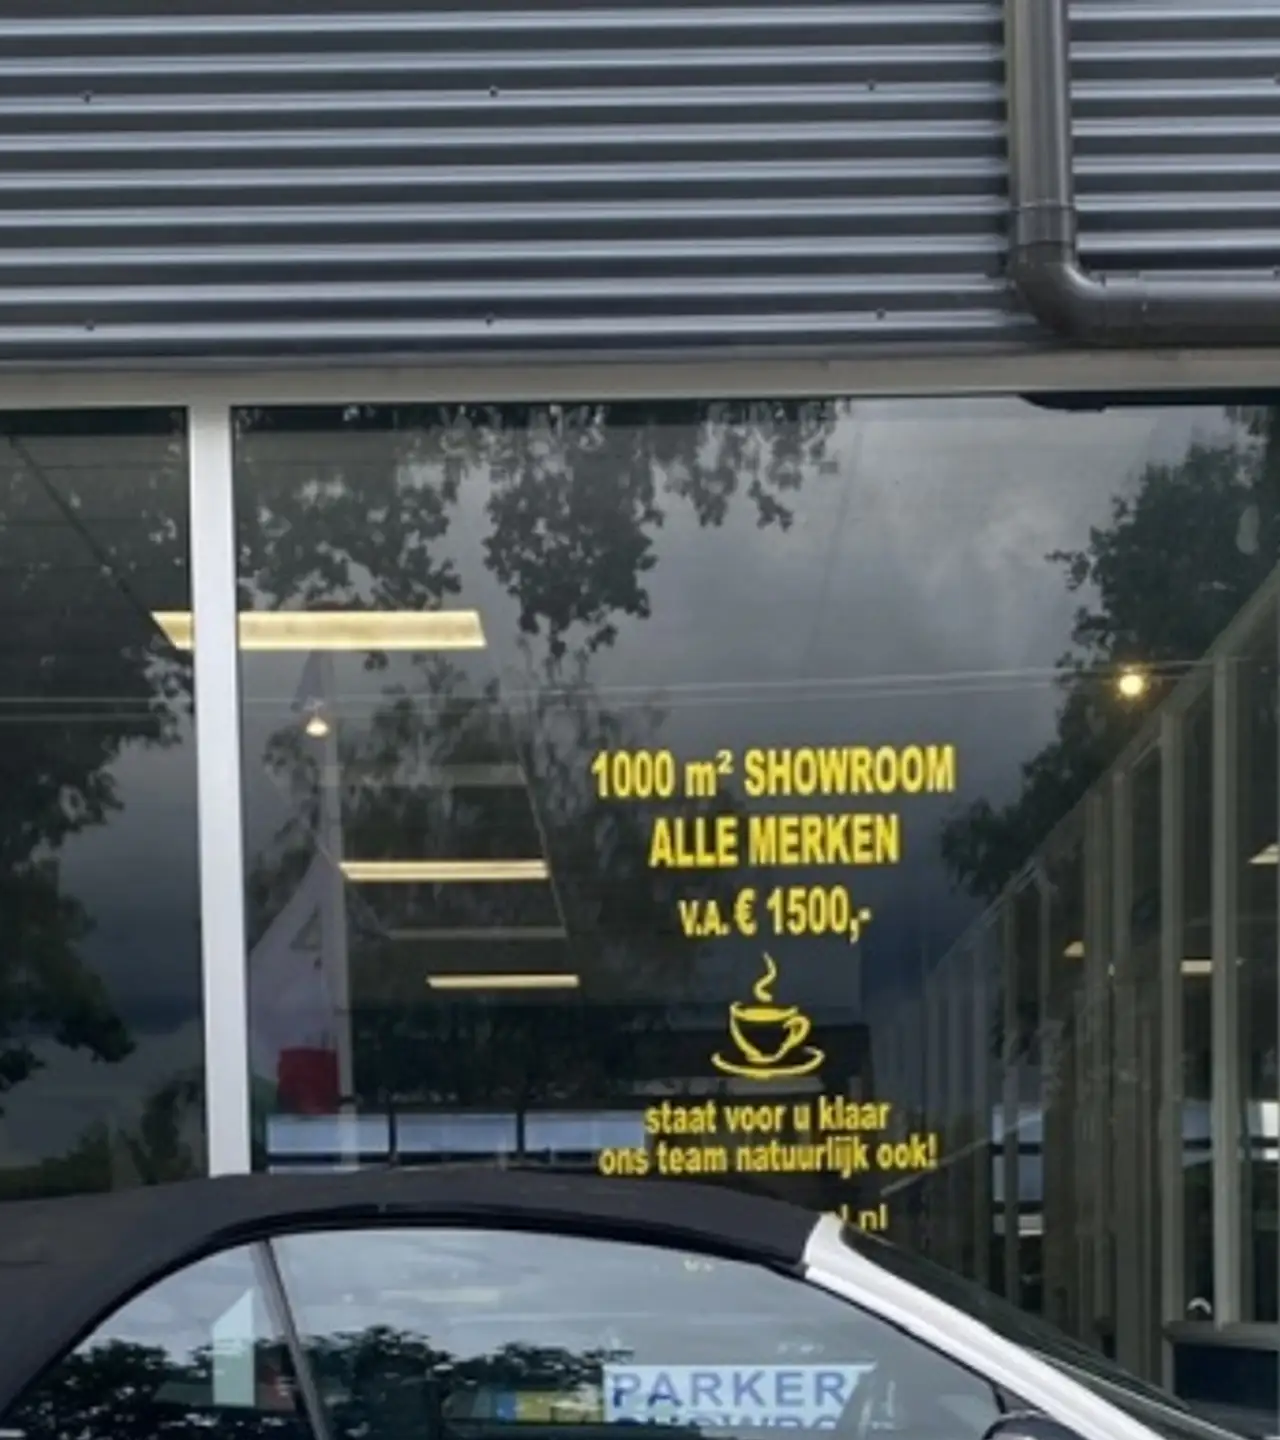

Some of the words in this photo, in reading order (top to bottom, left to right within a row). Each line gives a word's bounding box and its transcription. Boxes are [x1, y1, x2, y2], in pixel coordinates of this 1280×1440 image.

[591, 750, 676, 799] 1000
[743, 745, 956, 797] SHOWROOM
[649, 817, 739, 867] ALLE
[748, 813, 900, 866] MERKEN
[678, 900, 730, 936] V.A.
[733, 888, 757, 937] €
[766, 886, 872, 944] 1500,-
[644, 1100, 717, 1134] staat
[724, 1105, 786, 1133] voor
[792, 1106, 811, 1130] u
[819, 1096, 890, 1130] klaar
[598, 1148, 649, 1175] ons
[656, 1142, 728, 1174] team
[735, 1136, 869, 1178] natuurlijk
[876, 1133, 938, 1169] ook!
